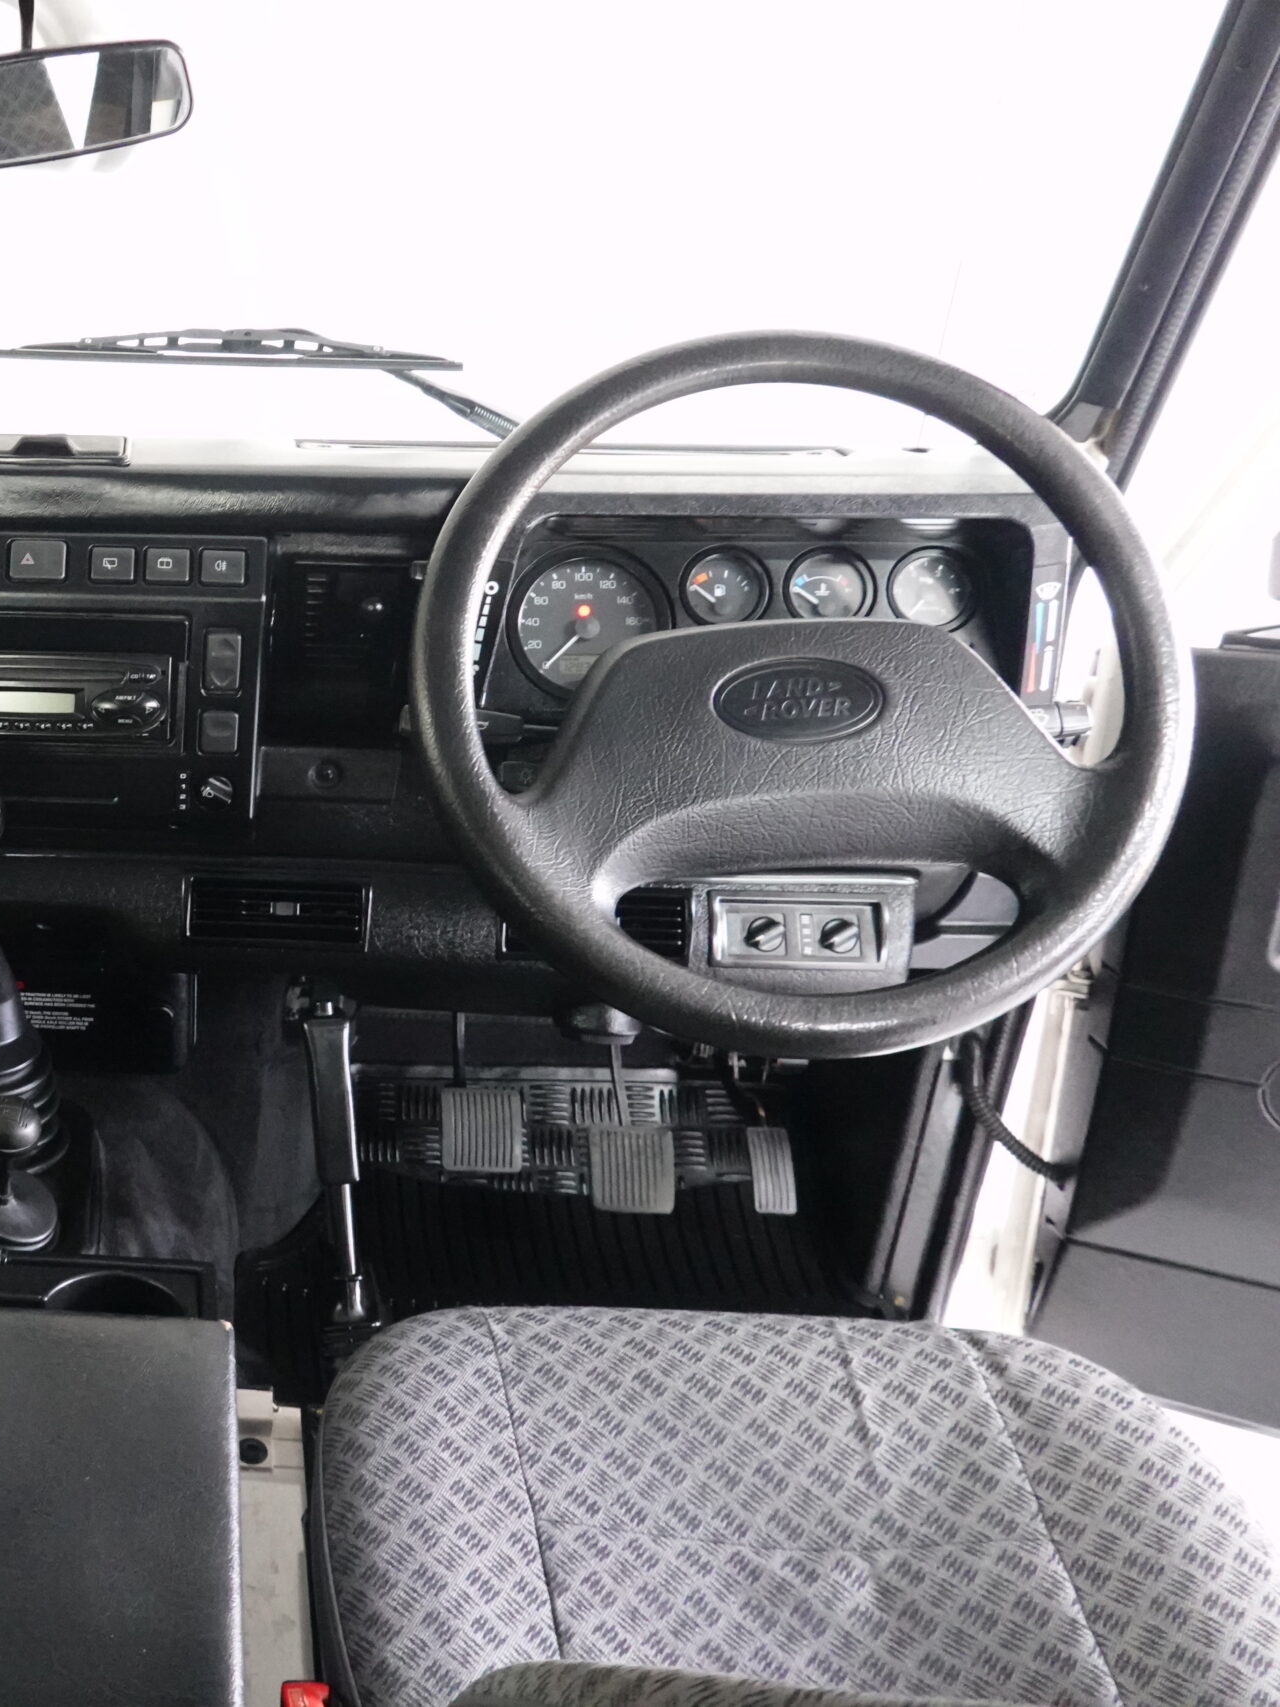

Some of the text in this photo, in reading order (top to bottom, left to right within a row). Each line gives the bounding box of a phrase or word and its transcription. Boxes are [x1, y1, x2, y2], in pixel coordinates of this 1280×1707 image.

[574, 572, 593, 581] 100
[551, 581, 566, 590] 80
[599, 580, 617, 589] 120
[534, 596, 549, 605] 60
[616, 595, 634, 604] 140
[525, 617, 540, 626] 40
[625, 617, 642, 626] 160
[527, 640, 542, 649] 20
[751, 676, 825, 700] LAND
[761, 697, 852, 721] ROVER
